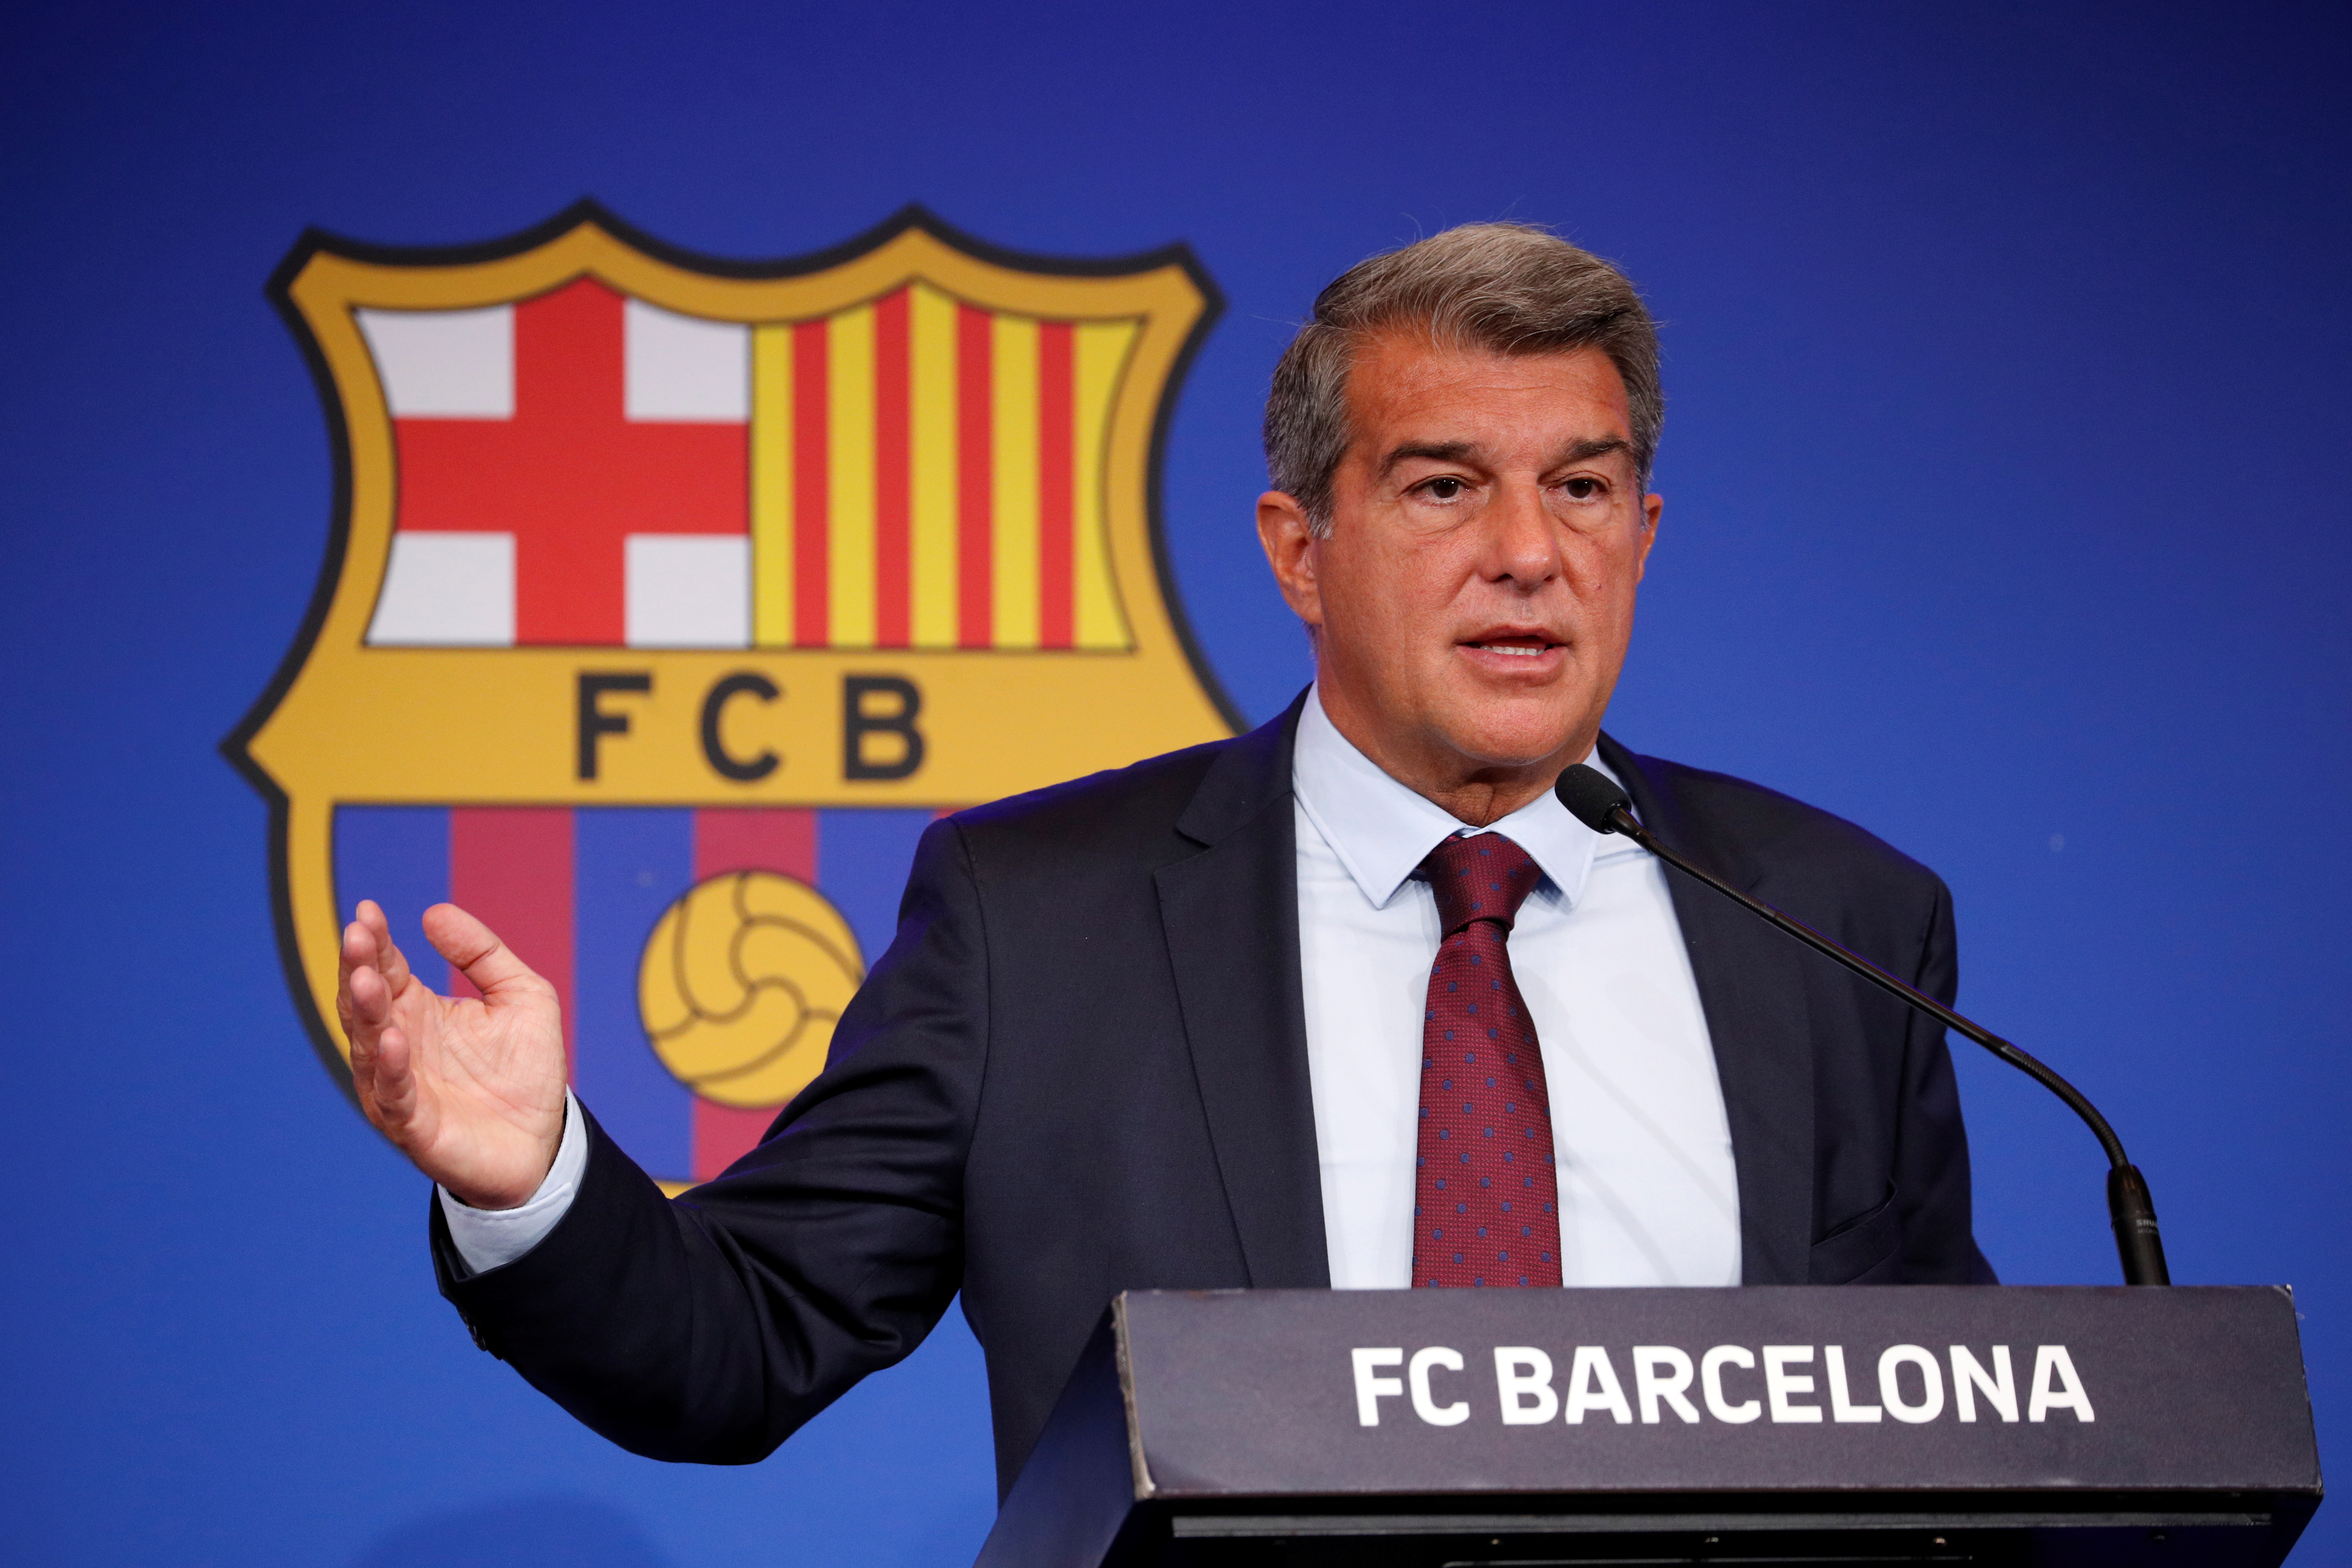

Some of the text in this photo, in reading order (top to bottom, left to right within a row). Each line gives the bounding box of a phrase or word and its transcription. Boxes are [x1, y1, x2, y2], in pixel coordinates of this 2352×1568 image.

[576, 670, 926, 784] FCB
[1351, 1344, 2095, 1427] FC BARCELONA
